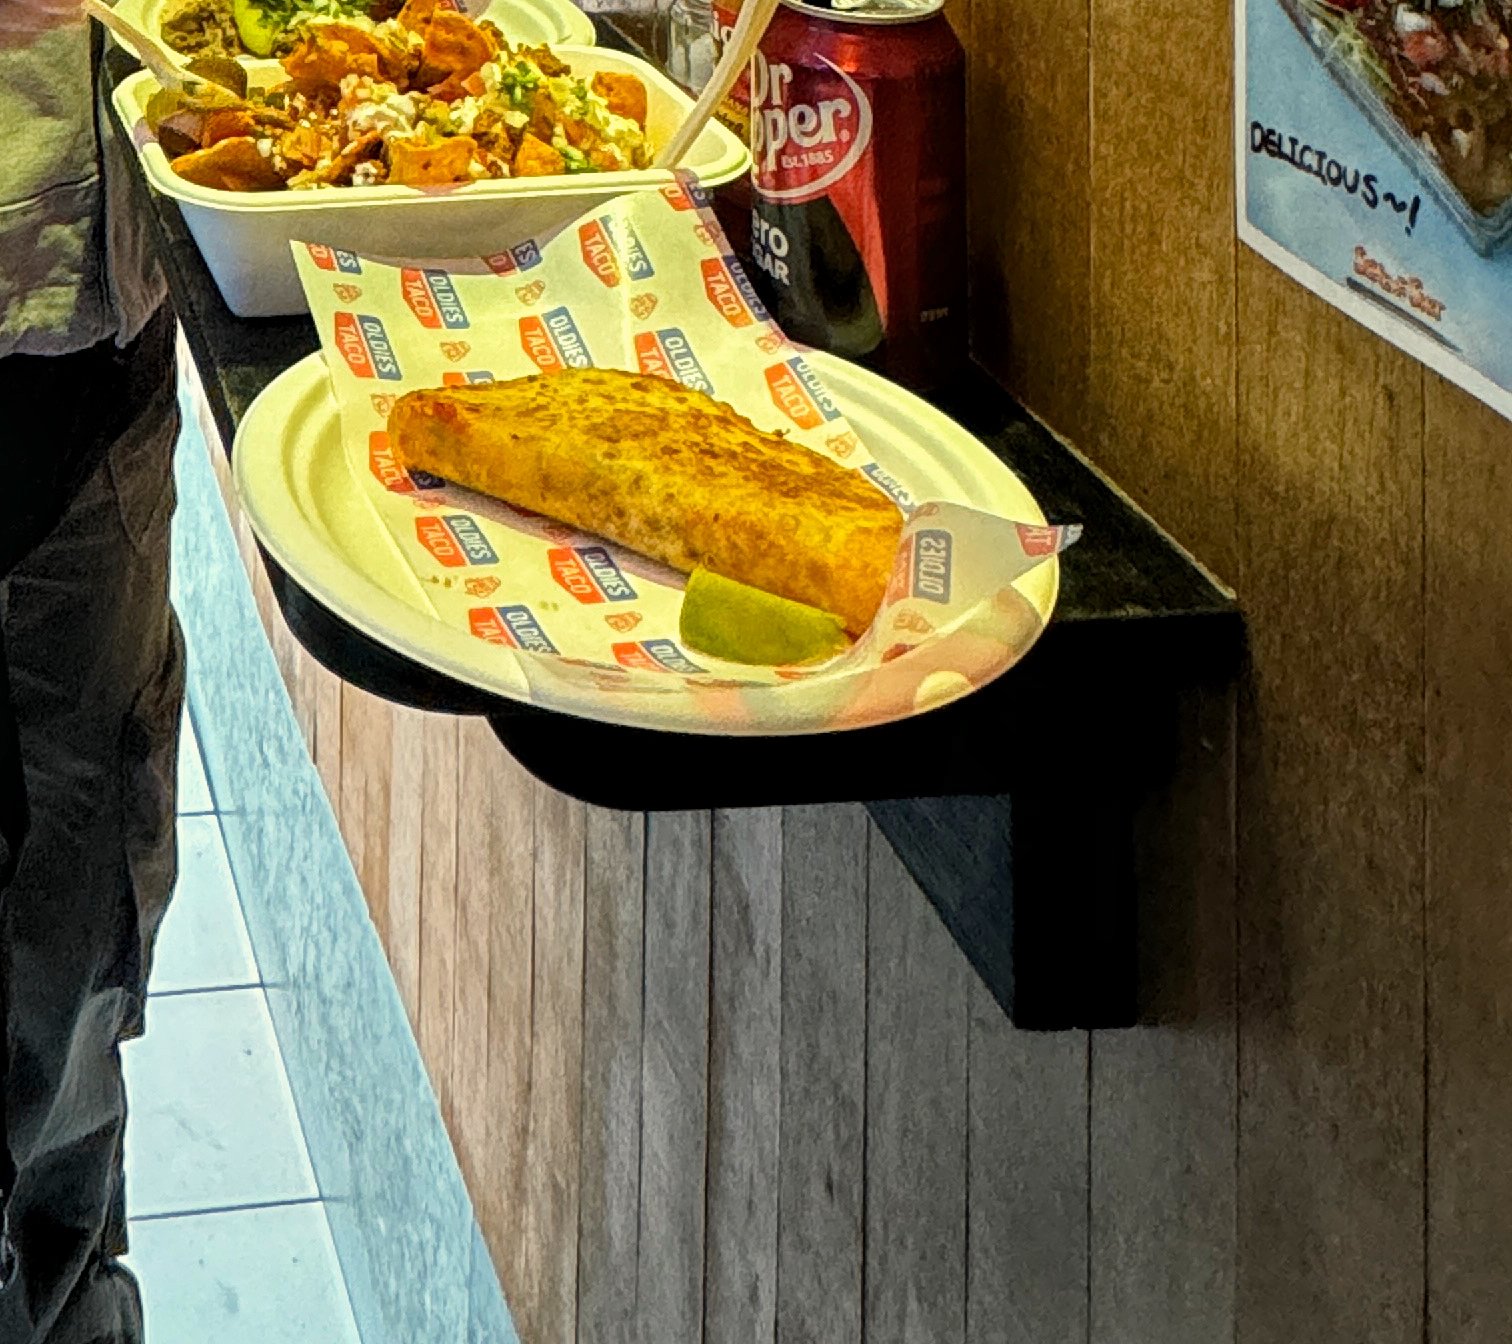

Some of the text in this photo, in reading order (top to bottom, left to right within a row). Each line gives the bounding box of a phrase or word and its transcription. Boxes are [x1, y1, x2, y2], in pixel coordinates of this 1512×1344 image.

[584, 231, 616, 277] TACO
[405, 277, 434, 320] TACO
[429, 274, 465, 325] OLDIES
[707, 270, 742, 317] TACO
[338, 323, 367, 366] TACO
[362, 320, 398, 375] OLDIES
[523, 325, 556, 367] TACO
[548, 313, 589, 369] OLDIES
[771, 373, 810, 420] TACO
[424, 523, 456, 557] TACO
[449, 517, 492, 561] OLDIES
[554, 558, 592, 594] TACO
[583, 552, 631, 597] OLDIES
